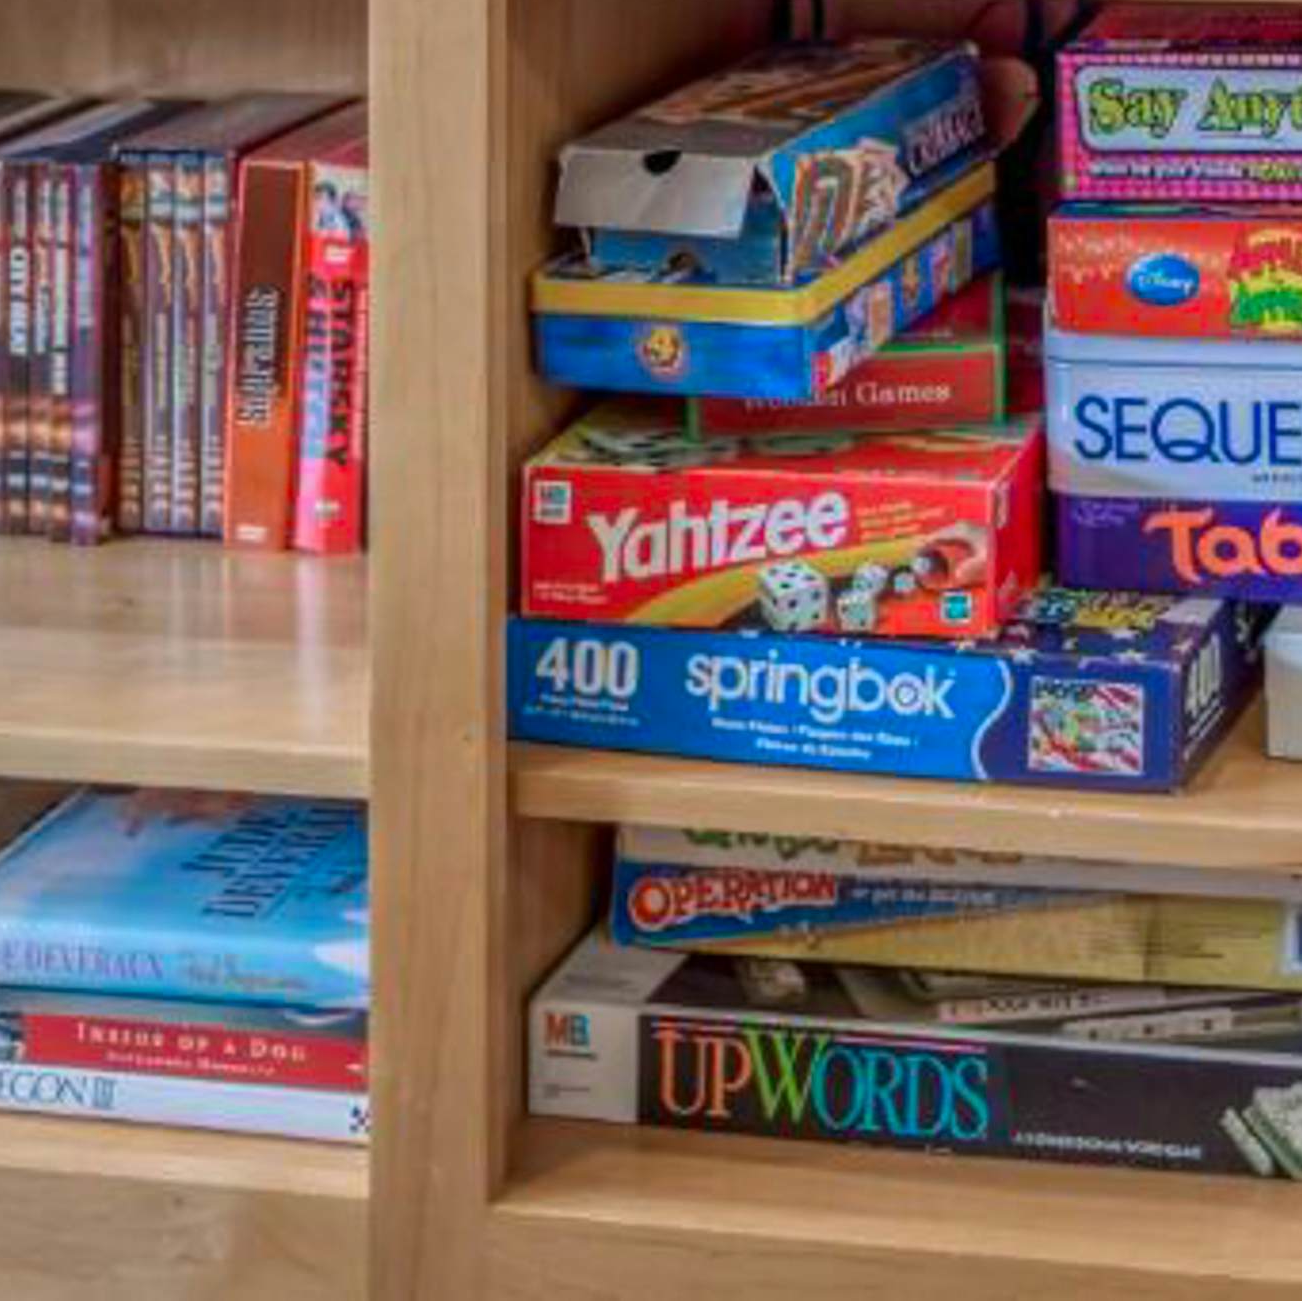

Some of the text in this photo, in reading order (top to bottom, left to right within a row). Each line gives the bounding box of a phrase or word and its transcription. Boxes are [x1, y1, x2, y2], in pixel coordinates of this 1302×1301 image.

[1089, 79, 1181, 135] Say
[855, 382, 951, 406] Games
[591, 494, 847, 582] Yahtzee
[535, 640, 639, 698] 400
[685, 648, 955, 724] springbok
[629, 868, 837, 930] OPERATION
[545, 1012, 590, 1046] MB
[654, 1023, 989, 1140] UPWORDS
